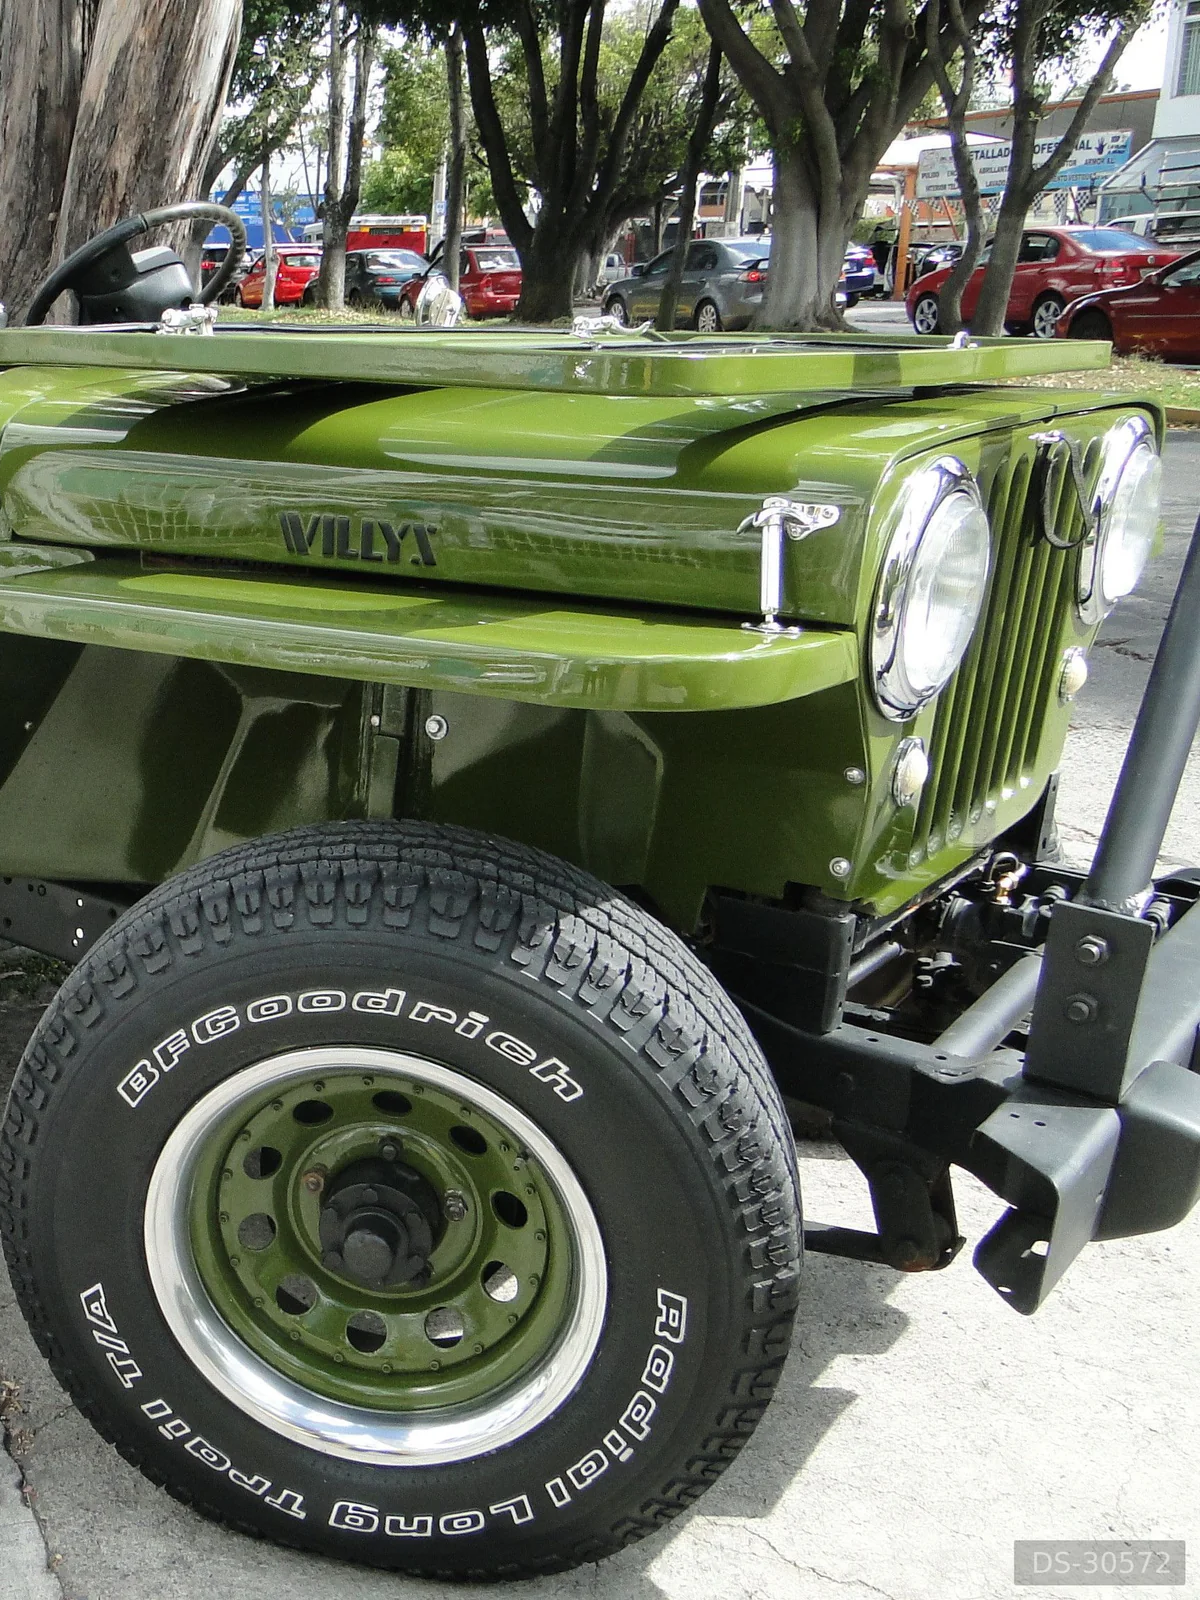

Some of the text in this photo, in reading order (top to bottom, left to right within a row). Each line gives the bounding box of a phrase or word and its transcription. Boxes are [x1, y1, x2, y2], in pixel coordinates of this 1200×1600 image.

[277, 510, 439, 566] WILLYS
[116, 988, 584, 1108] BFGoodrich
[79, 1283, 688, 1538] Radial Long Trail T/A
